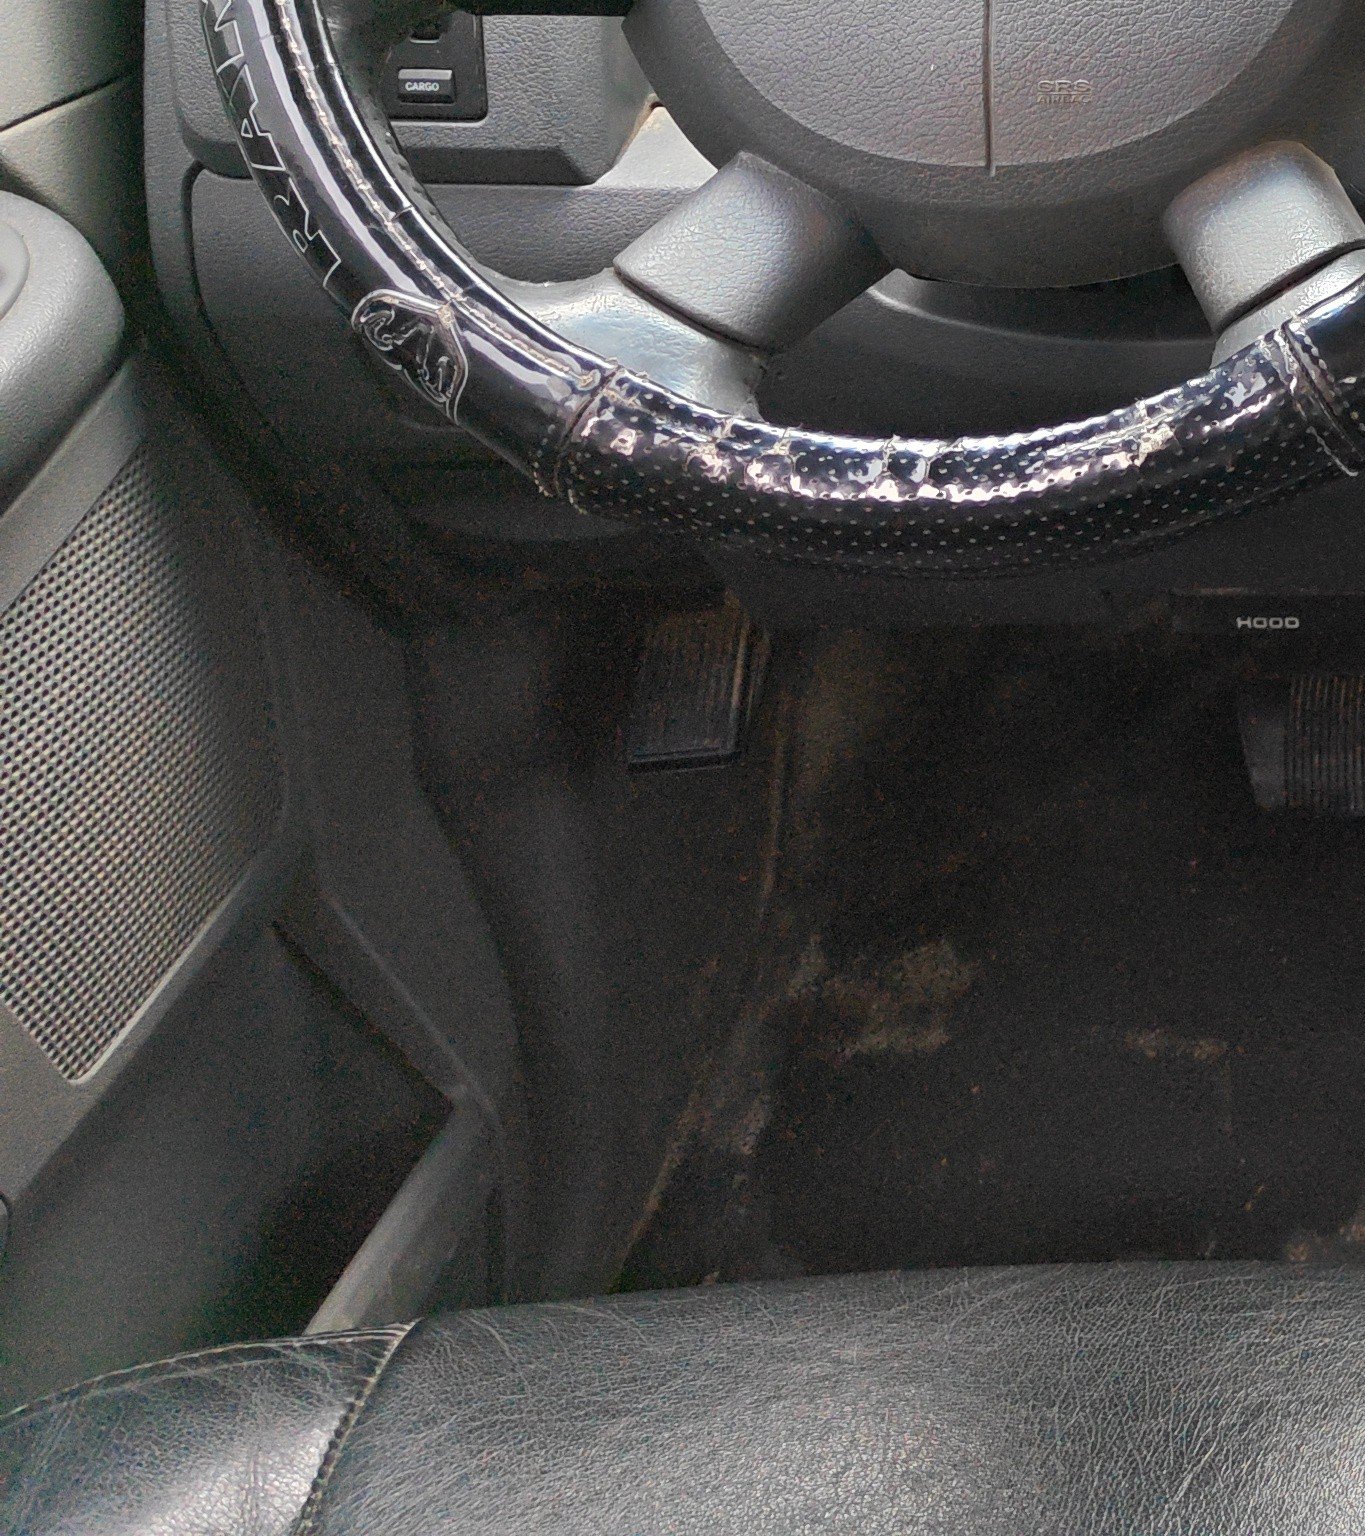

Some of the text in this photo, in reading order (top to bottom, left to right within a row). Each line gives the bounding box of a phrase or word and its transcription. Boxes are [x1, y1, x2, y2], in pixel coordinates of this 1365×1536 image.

[405, 81, 440, 92] CARGO
[1037, 78, 1092, 92] SRS
[1236, 616, 1300, 629] HOOD
